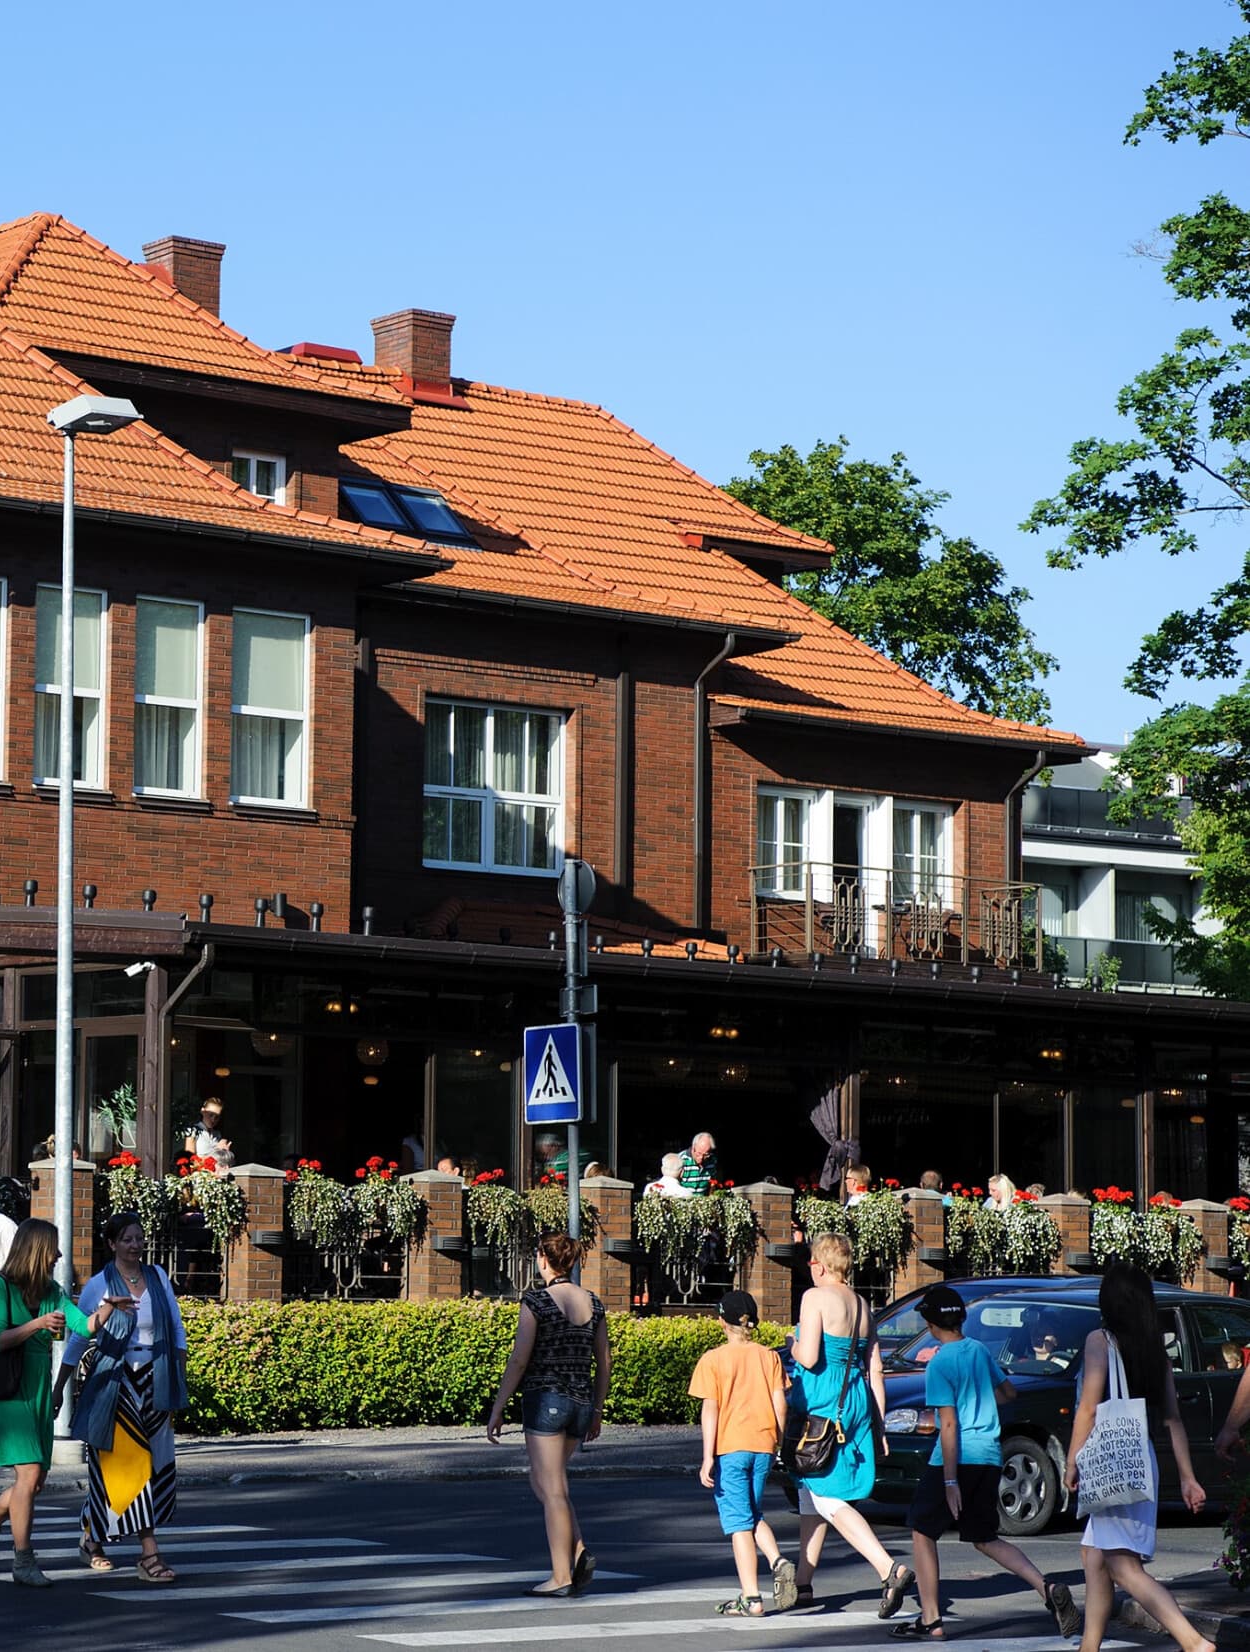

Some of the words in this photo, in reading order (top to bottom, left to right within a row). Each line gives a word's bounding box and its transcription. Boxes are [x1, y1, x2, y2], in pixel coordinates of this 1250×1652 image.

[1116, 1417, 1141, 1428] COINS
[1100, 1427, 1141, 1440] ARPHONES
[1117, 1449, 1143, 1460] STUFF
